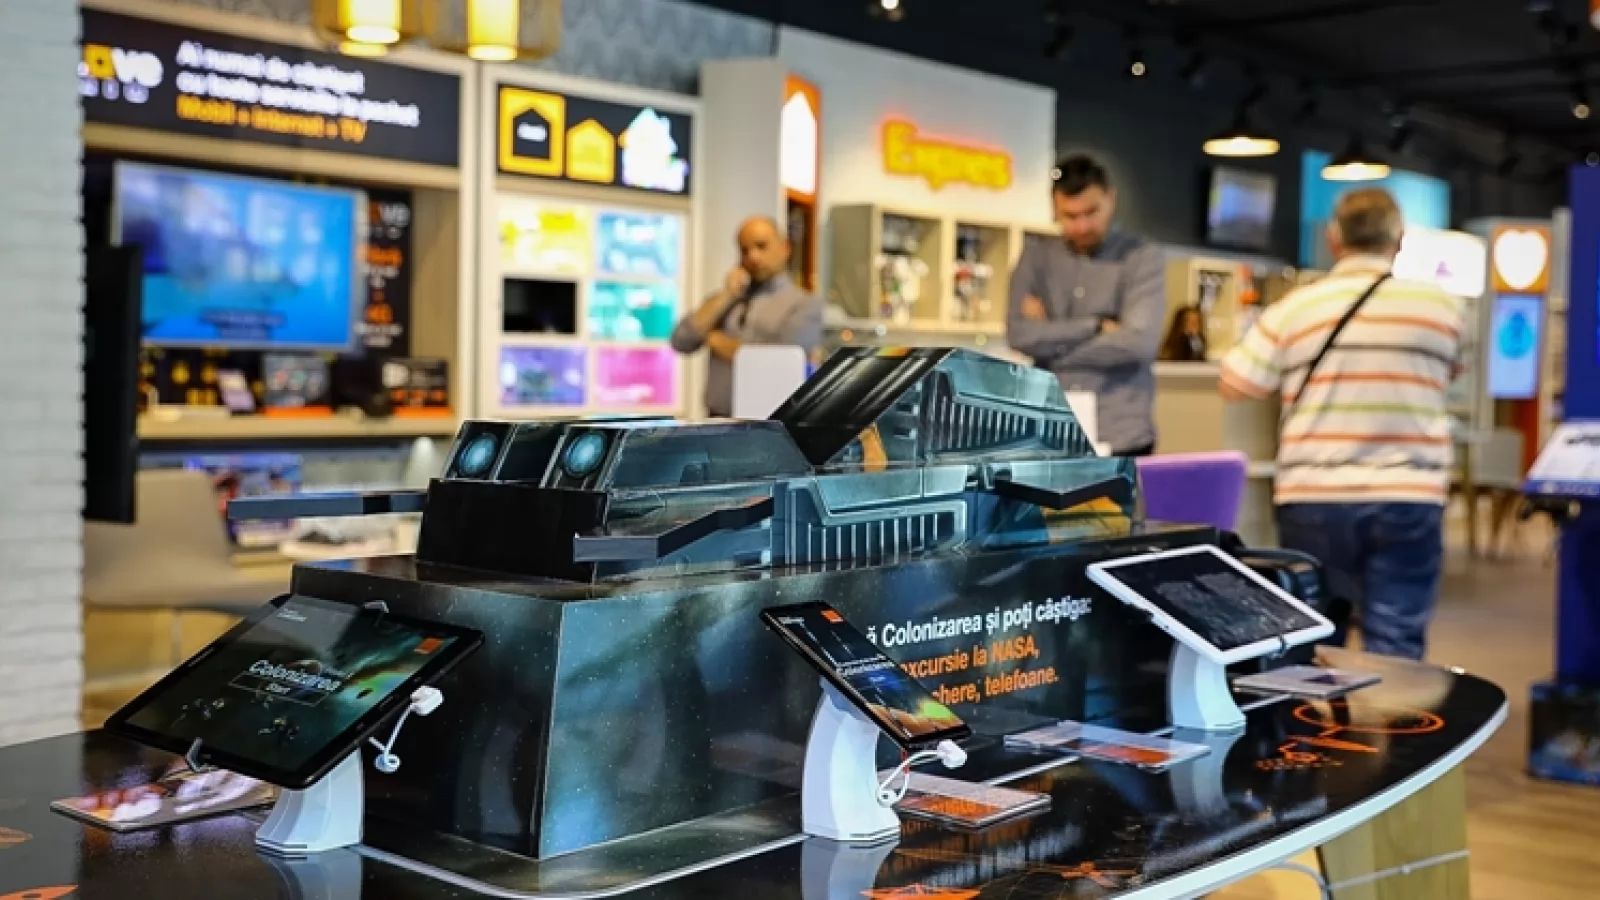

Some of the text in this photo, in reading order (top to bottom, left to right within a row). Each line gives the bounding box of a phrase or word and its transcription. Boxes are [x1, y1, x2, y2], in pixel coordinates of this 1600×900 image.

[176, 93, 236, 125] Mobil
[251, 105, 325, 138] Internet
[866, 625, 878, 646] ă
[882, 615, 983, 647] Colonizarea
[985, 606, 1000, 636] și
[1003, 600, 1032, 632] poți
[973, 644, 987, 666] la
[992, 634, 1040, 661] NASA,
[985, 666, 1060, 697] telefoane.
